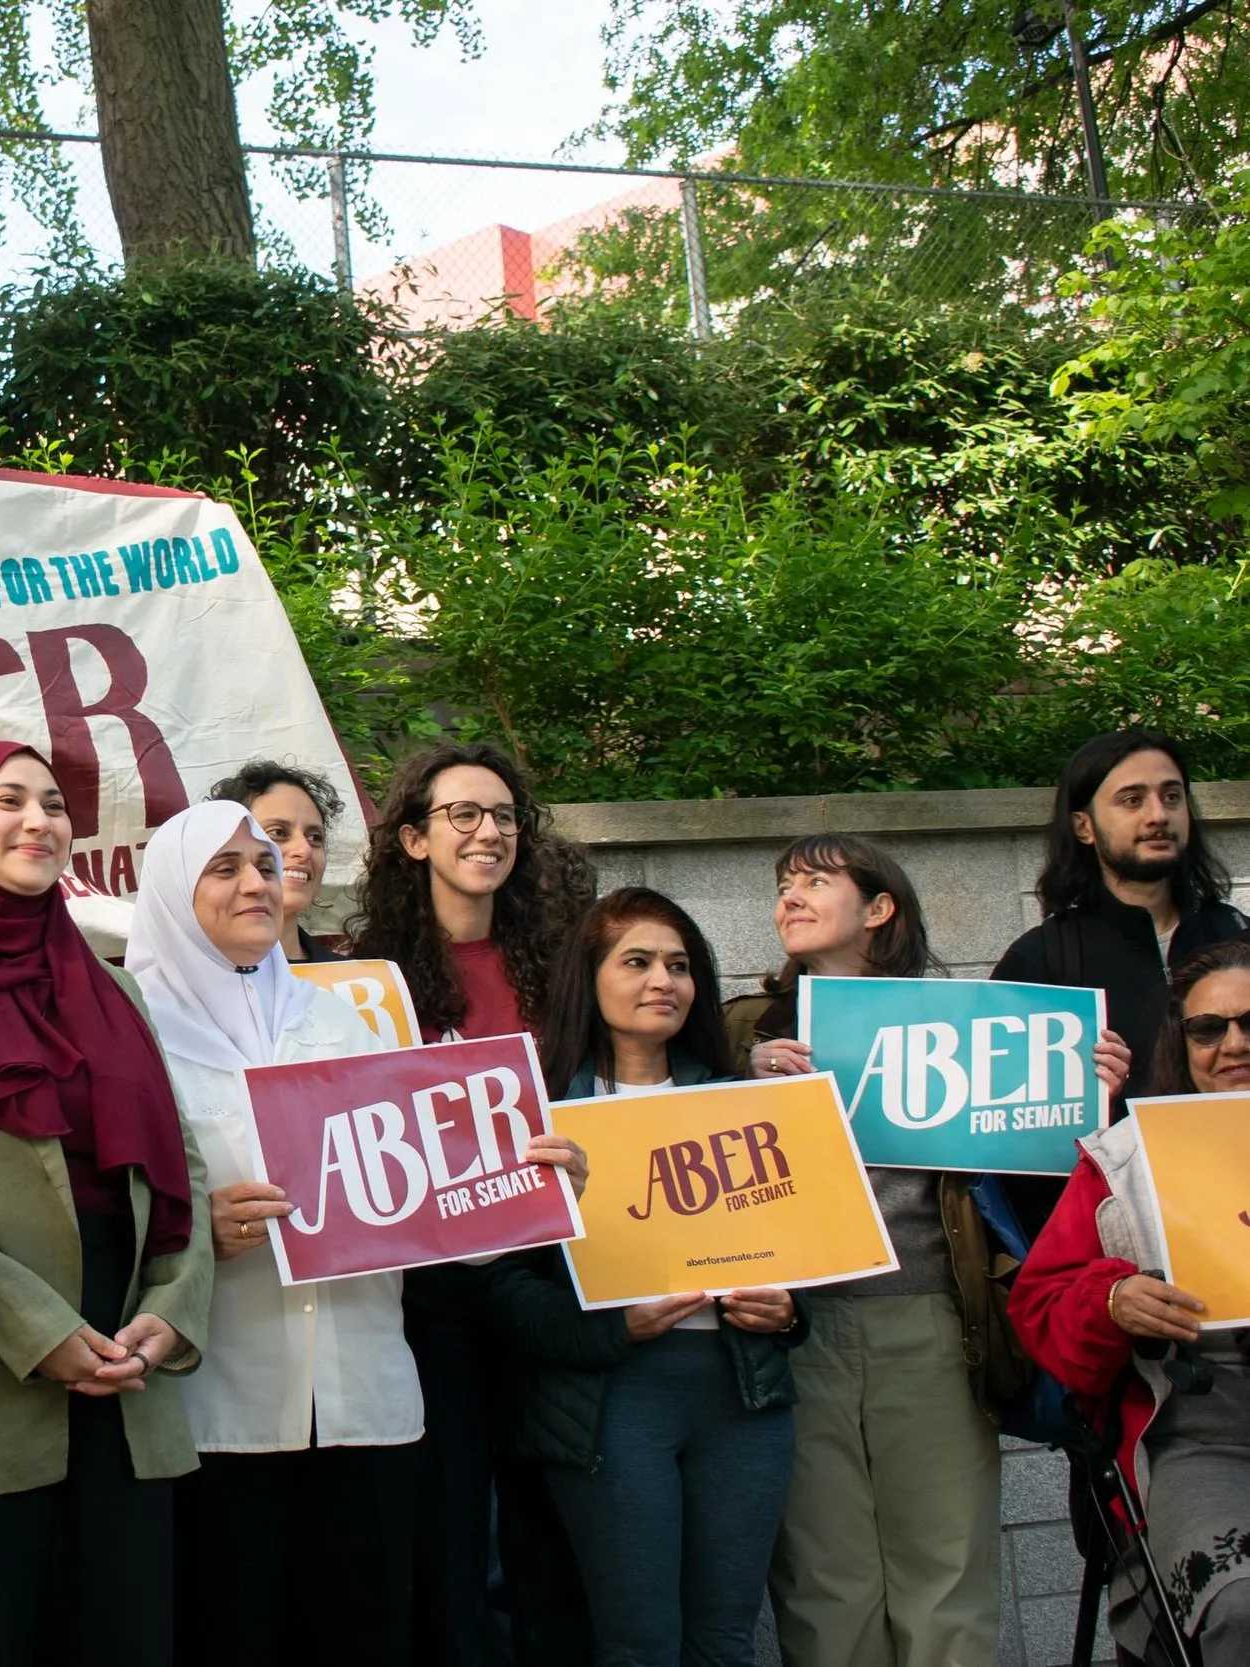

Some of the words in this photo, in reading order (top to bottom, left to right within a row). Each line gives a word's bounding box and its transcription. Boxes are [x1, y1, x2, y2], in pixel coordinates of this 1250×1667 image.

[49, 550, 119, 600] THE
[118, 527, 240, 593] WORLD
[849, 1012, 1085, 1130] ABER
[970, 1108, 1007, 1134] FOR
[1012, 1102, 1085, 1130] SENATE
[288, 1066, 531, 1235] ABER
[626, 1121, 791, 1220] ABER
[436, 1188, 476, 1219] FOR
[477, 1164, 545, 1206] SENATE
[724, 1191, 750, 1213] FOR
[750, 1180, 797, 1206] SENATE
[686, 1249, 775, 1267] aberforsenate.com
